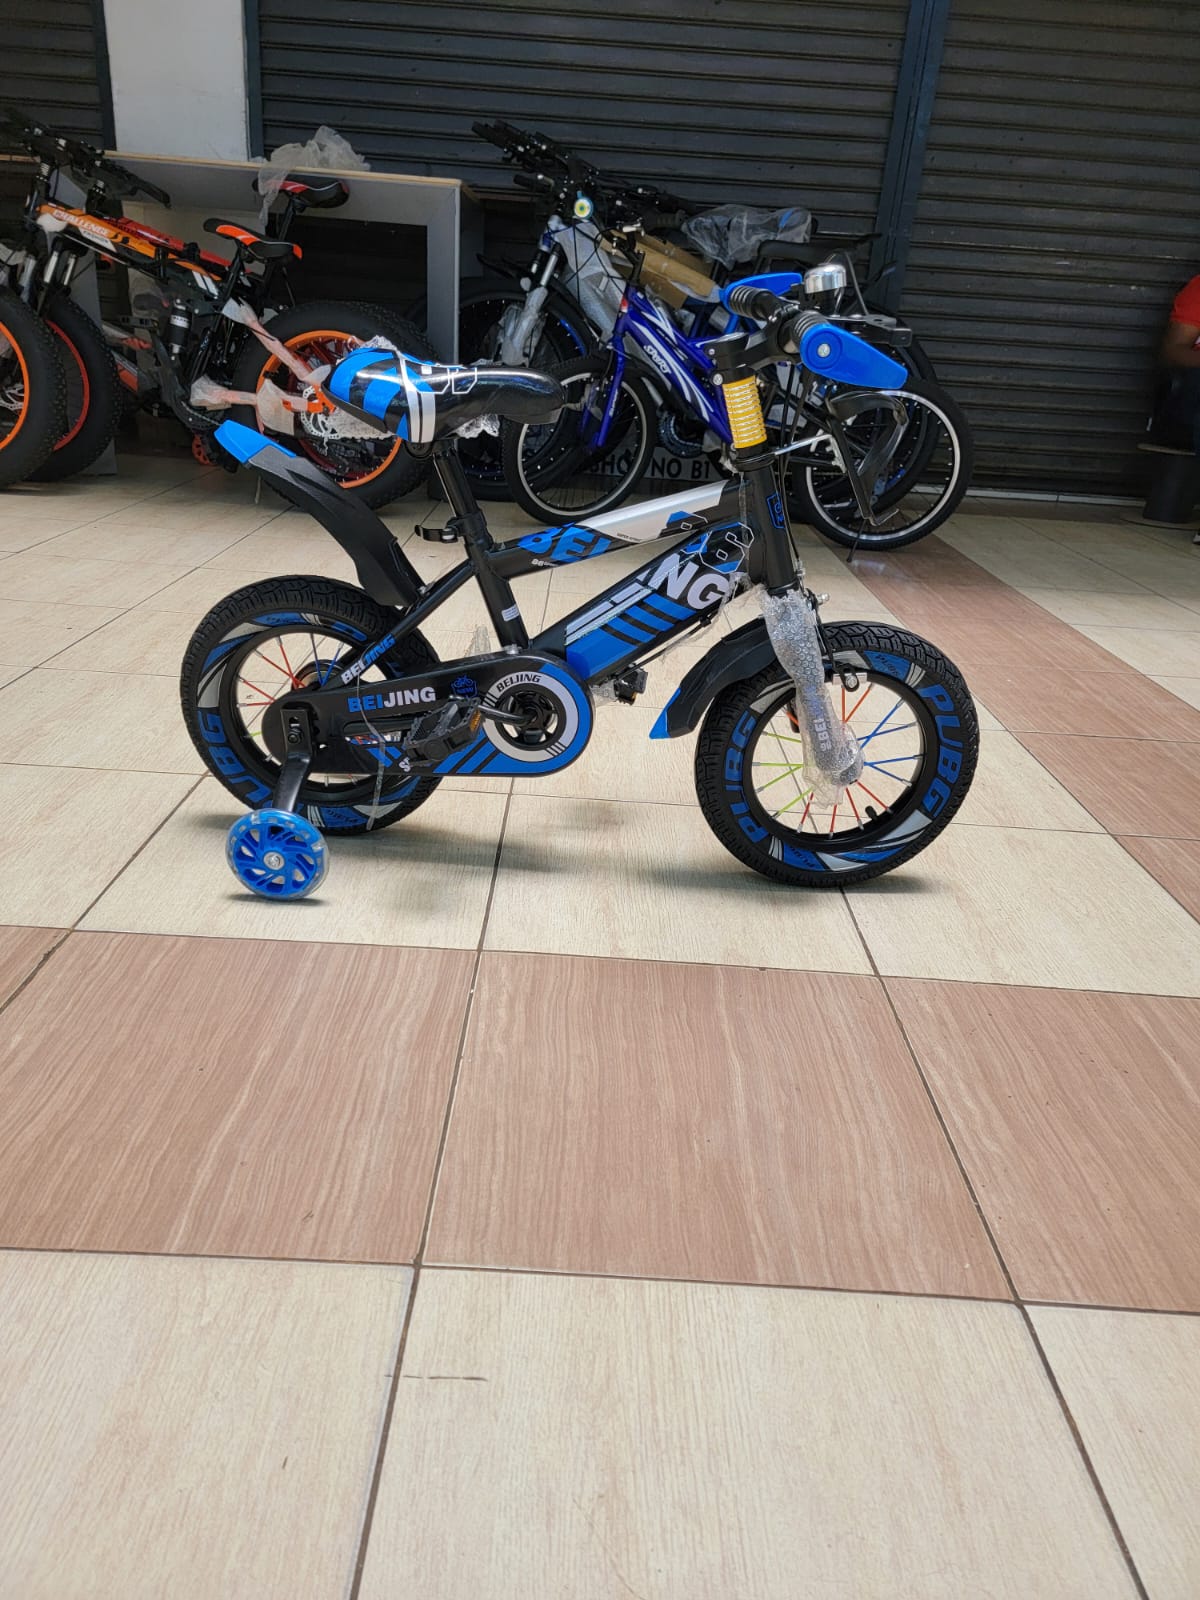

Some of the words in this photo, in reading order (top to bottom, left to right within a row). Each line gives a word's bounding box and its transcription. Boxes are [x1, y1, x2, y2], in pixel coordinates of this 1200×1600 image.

[651, 457, 682, 479] NO
[341, 633, 396, 684] BEIJING
[496, 673, 542, 692] BEIJING
[347, 686, 437, 713] BEIJING
[197, 709, 273, 808] UBG
[724, 709, 769, 843] PUBG
[917, 684, 965, 818] PUBG
